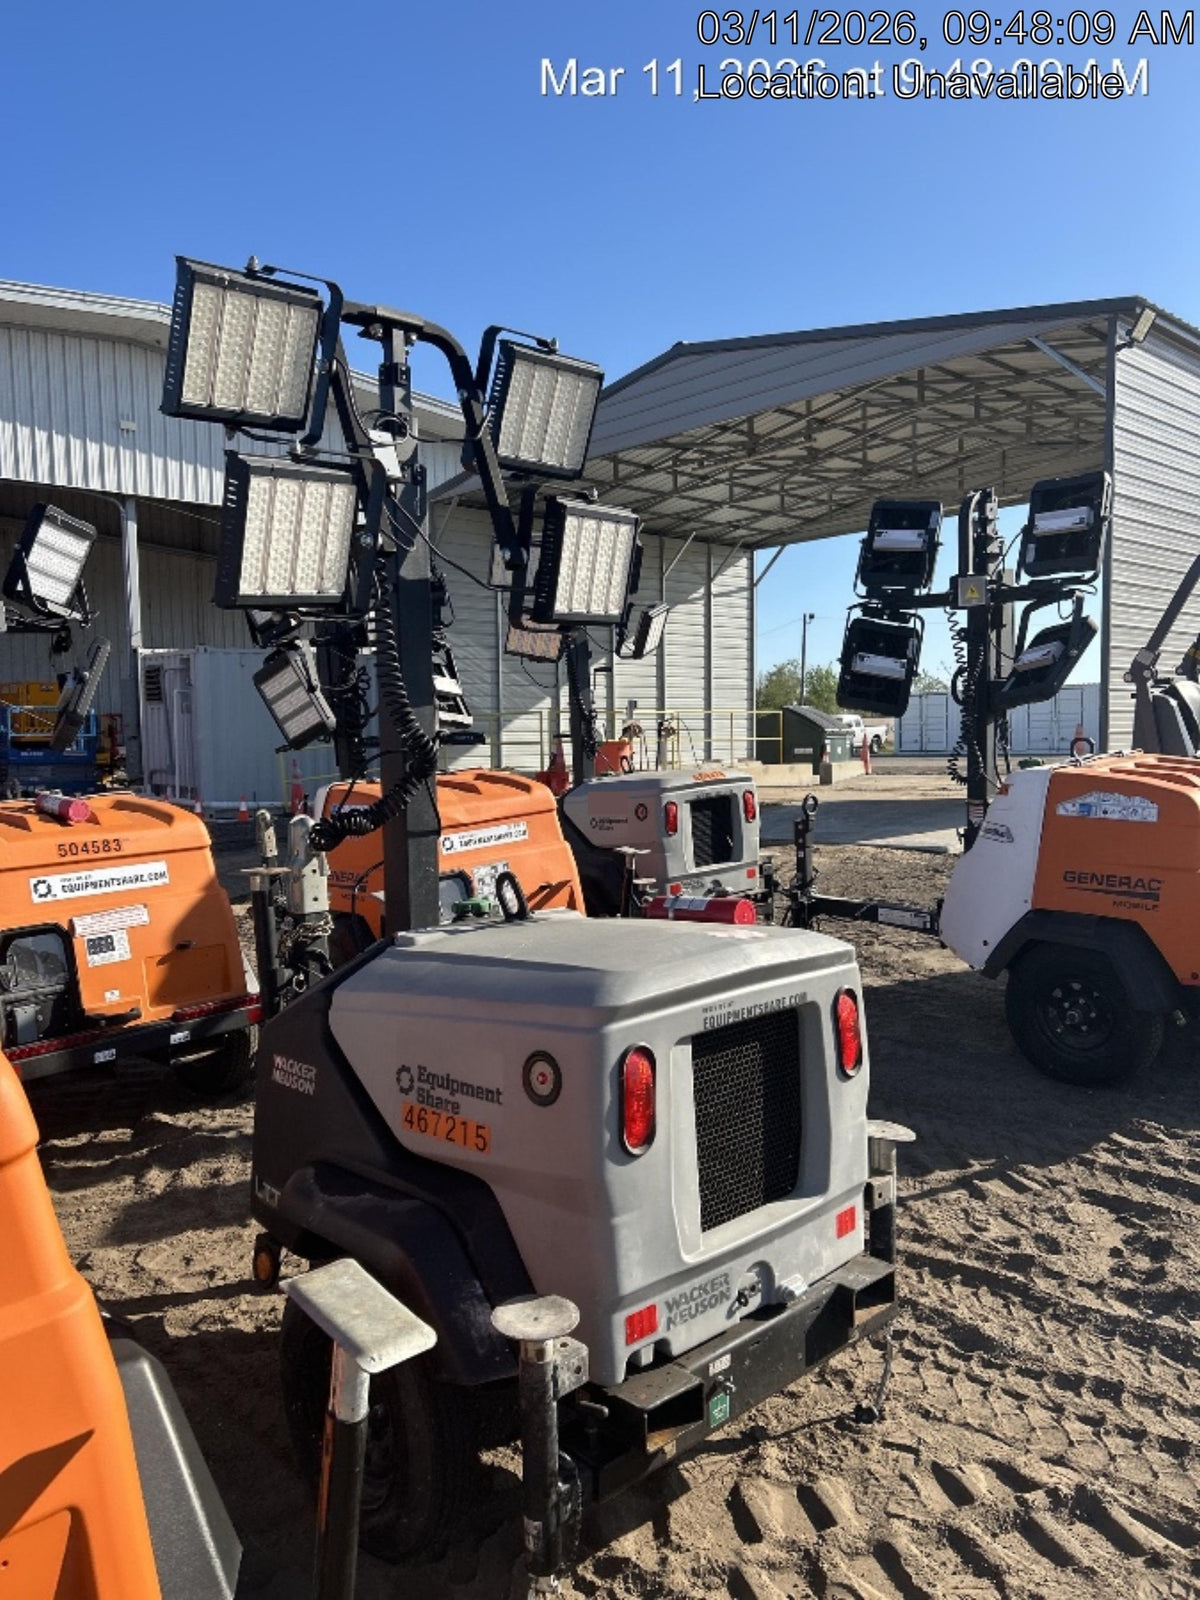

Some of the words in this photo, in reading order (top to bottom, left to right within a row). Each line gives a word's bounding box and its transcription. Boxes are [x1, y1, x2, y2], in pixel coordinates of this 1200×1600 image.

[57, 838, 123, 858] 504583
[61, 871, 168, 894] EQUIPMENTSHARE.COM
[1063, 870, 1163, 892] GENERAC
[1112, 900, 1159, 911] MOBILE
[703, 991, 808, 1030] EQUIPMENTSHARE.COM
[271, 1067, 316, 1096] NEUSON
[273, 1053, 317, 1081] WACKER
[417, 1065, 503, 1106] Equipment
[416, 1087, 461, 1116] Share
[404, 1104, 488, 1153] 467215
[664, 1272, 731, 1314] WACKER
[665, 1287, 731, 1332] NEUSON
